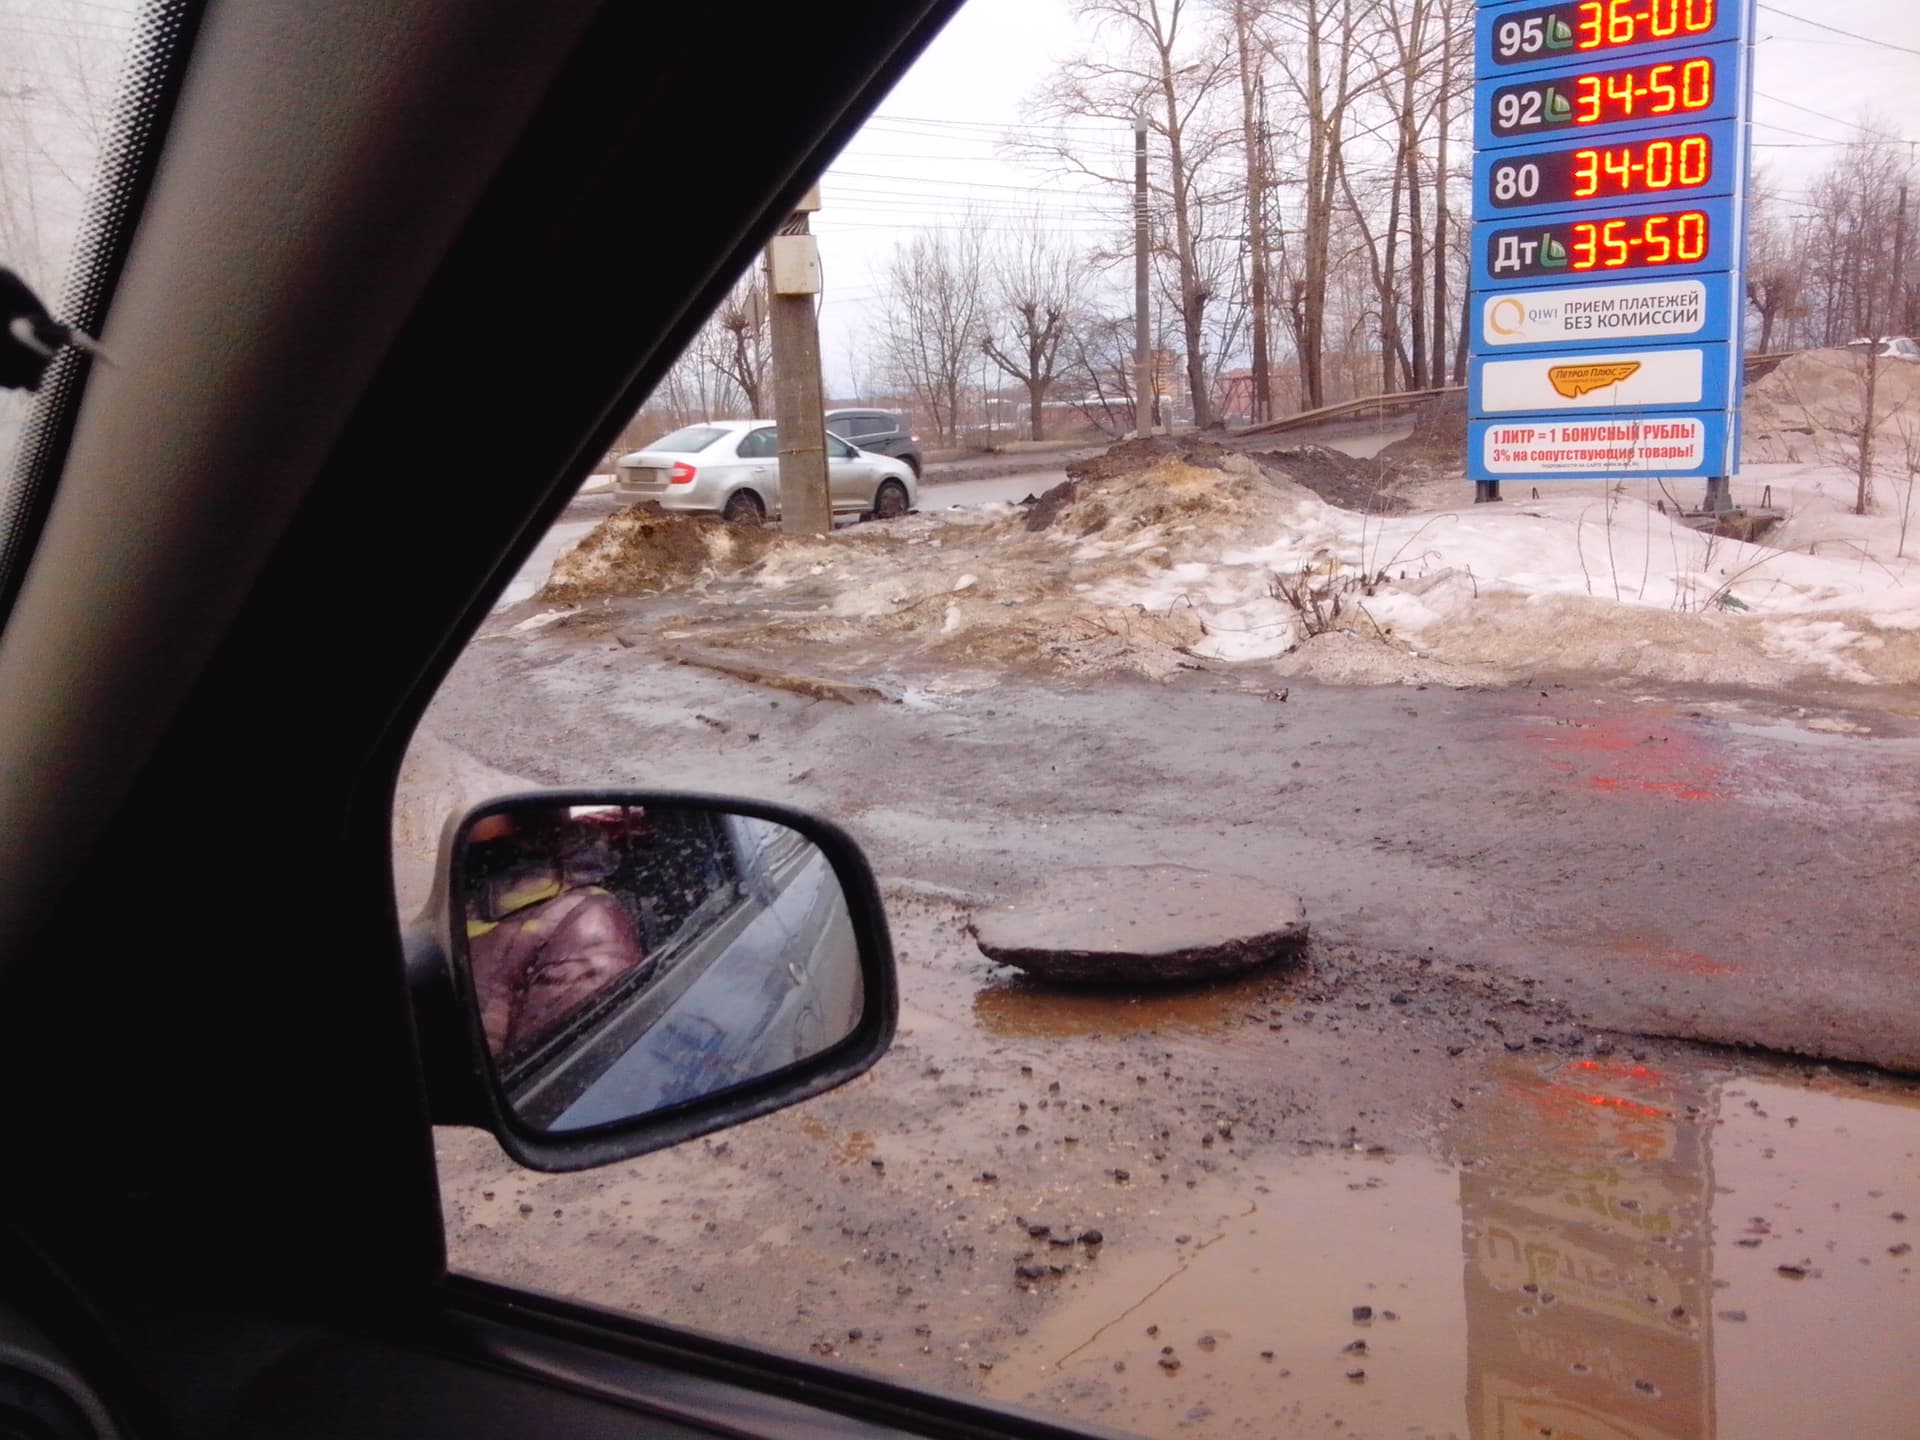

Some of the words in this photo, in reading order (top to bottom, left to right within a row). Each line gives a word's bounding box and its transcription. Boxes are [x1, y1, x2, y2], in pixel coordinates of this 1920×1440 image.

[1499, 17, 1543, 56] 95
[1578, 0, 1712, 48] 36-00
[1498, 91, 1542, 128] 92
[1577, 60, 1710, 123] 34-50
[1495, 164, 1540, 200] 80
[1575, 137, 1707, 197] 34-00
[1494, 236, 1538, 272] Дт
[1573, 213, 1704, 268] 35-50
[1564, 300, 1614, 315] ПРИЕМ
[1619, 291, 1699, 311] ПЛАТЕЖЕЙ
[1528, 308, 1558, 323] QIWI
[1564, 315, 1592, 331] БЕЗ
[1597, 309, 1698, 329] КОМИССИИ
[1501, 429, 1534, 444] ЛИТР
[1550, 428, 1556, 443] 1
[1562, 424, 1640, 442] БОНУСНЫЙ
[1644, 423, 1695, 440] РУБЛЬ!
[1493, 448, 1510, 462] 3%
[1513, 451, 1527, 461] на
[1530, 447, 1634, 462] сопутствующие
[1639, 444, 1694, 459] товары!
